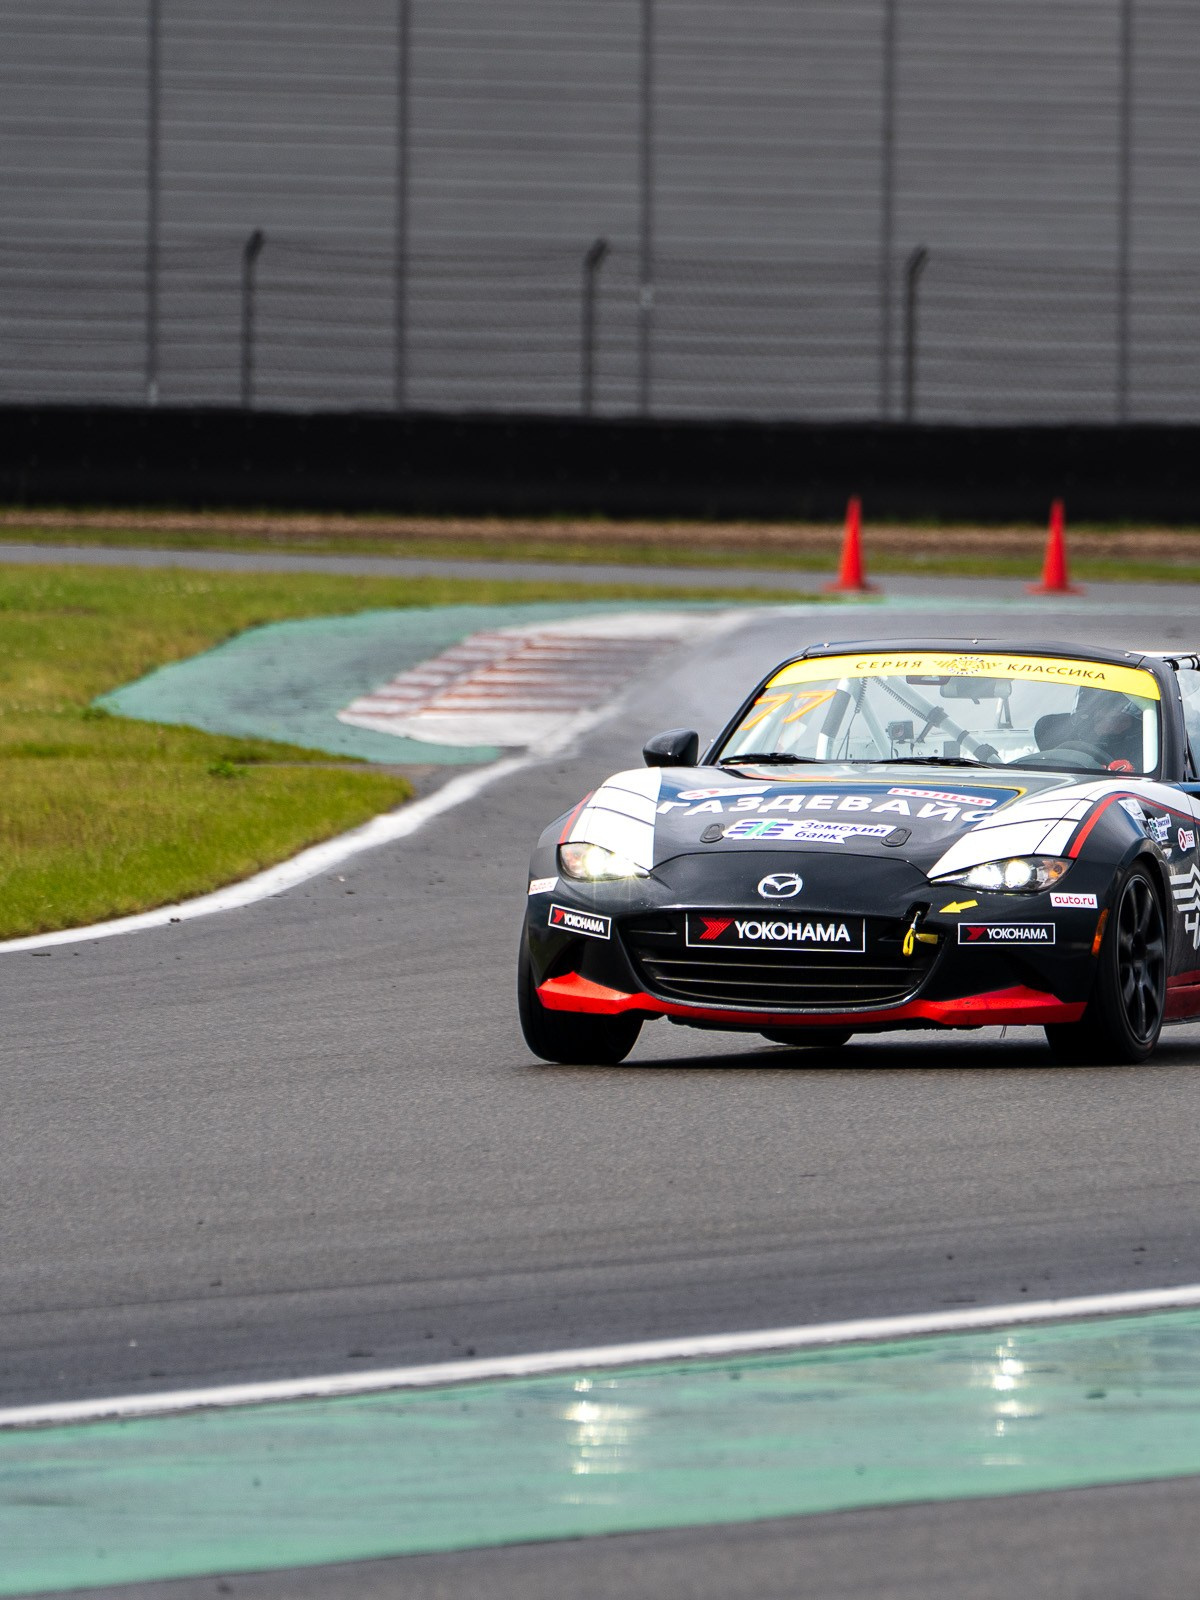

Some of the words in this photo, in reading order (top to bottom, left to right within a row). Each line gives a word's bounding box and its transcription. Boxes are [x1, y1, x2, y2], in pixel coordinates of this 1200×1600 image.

[855, 660, 922, 670] СЕРИЯ
[1006, 663, 1106, 681] КЛАССИКА
[741, 690, 837, 731] 77
[656, 794, 999, 822] ГАЗДЕВАЙС
[794, 831, 840, 840] банк
[801, 822, 887, 834] Земский
[1054, 895, 1095, 906] auto.ru
[563, 912, 604, 934] YOKOHAMA
[734, 920, 850, 942] YOKOHAMA
[987, 927, 1048, 940] YOKOHAMA
